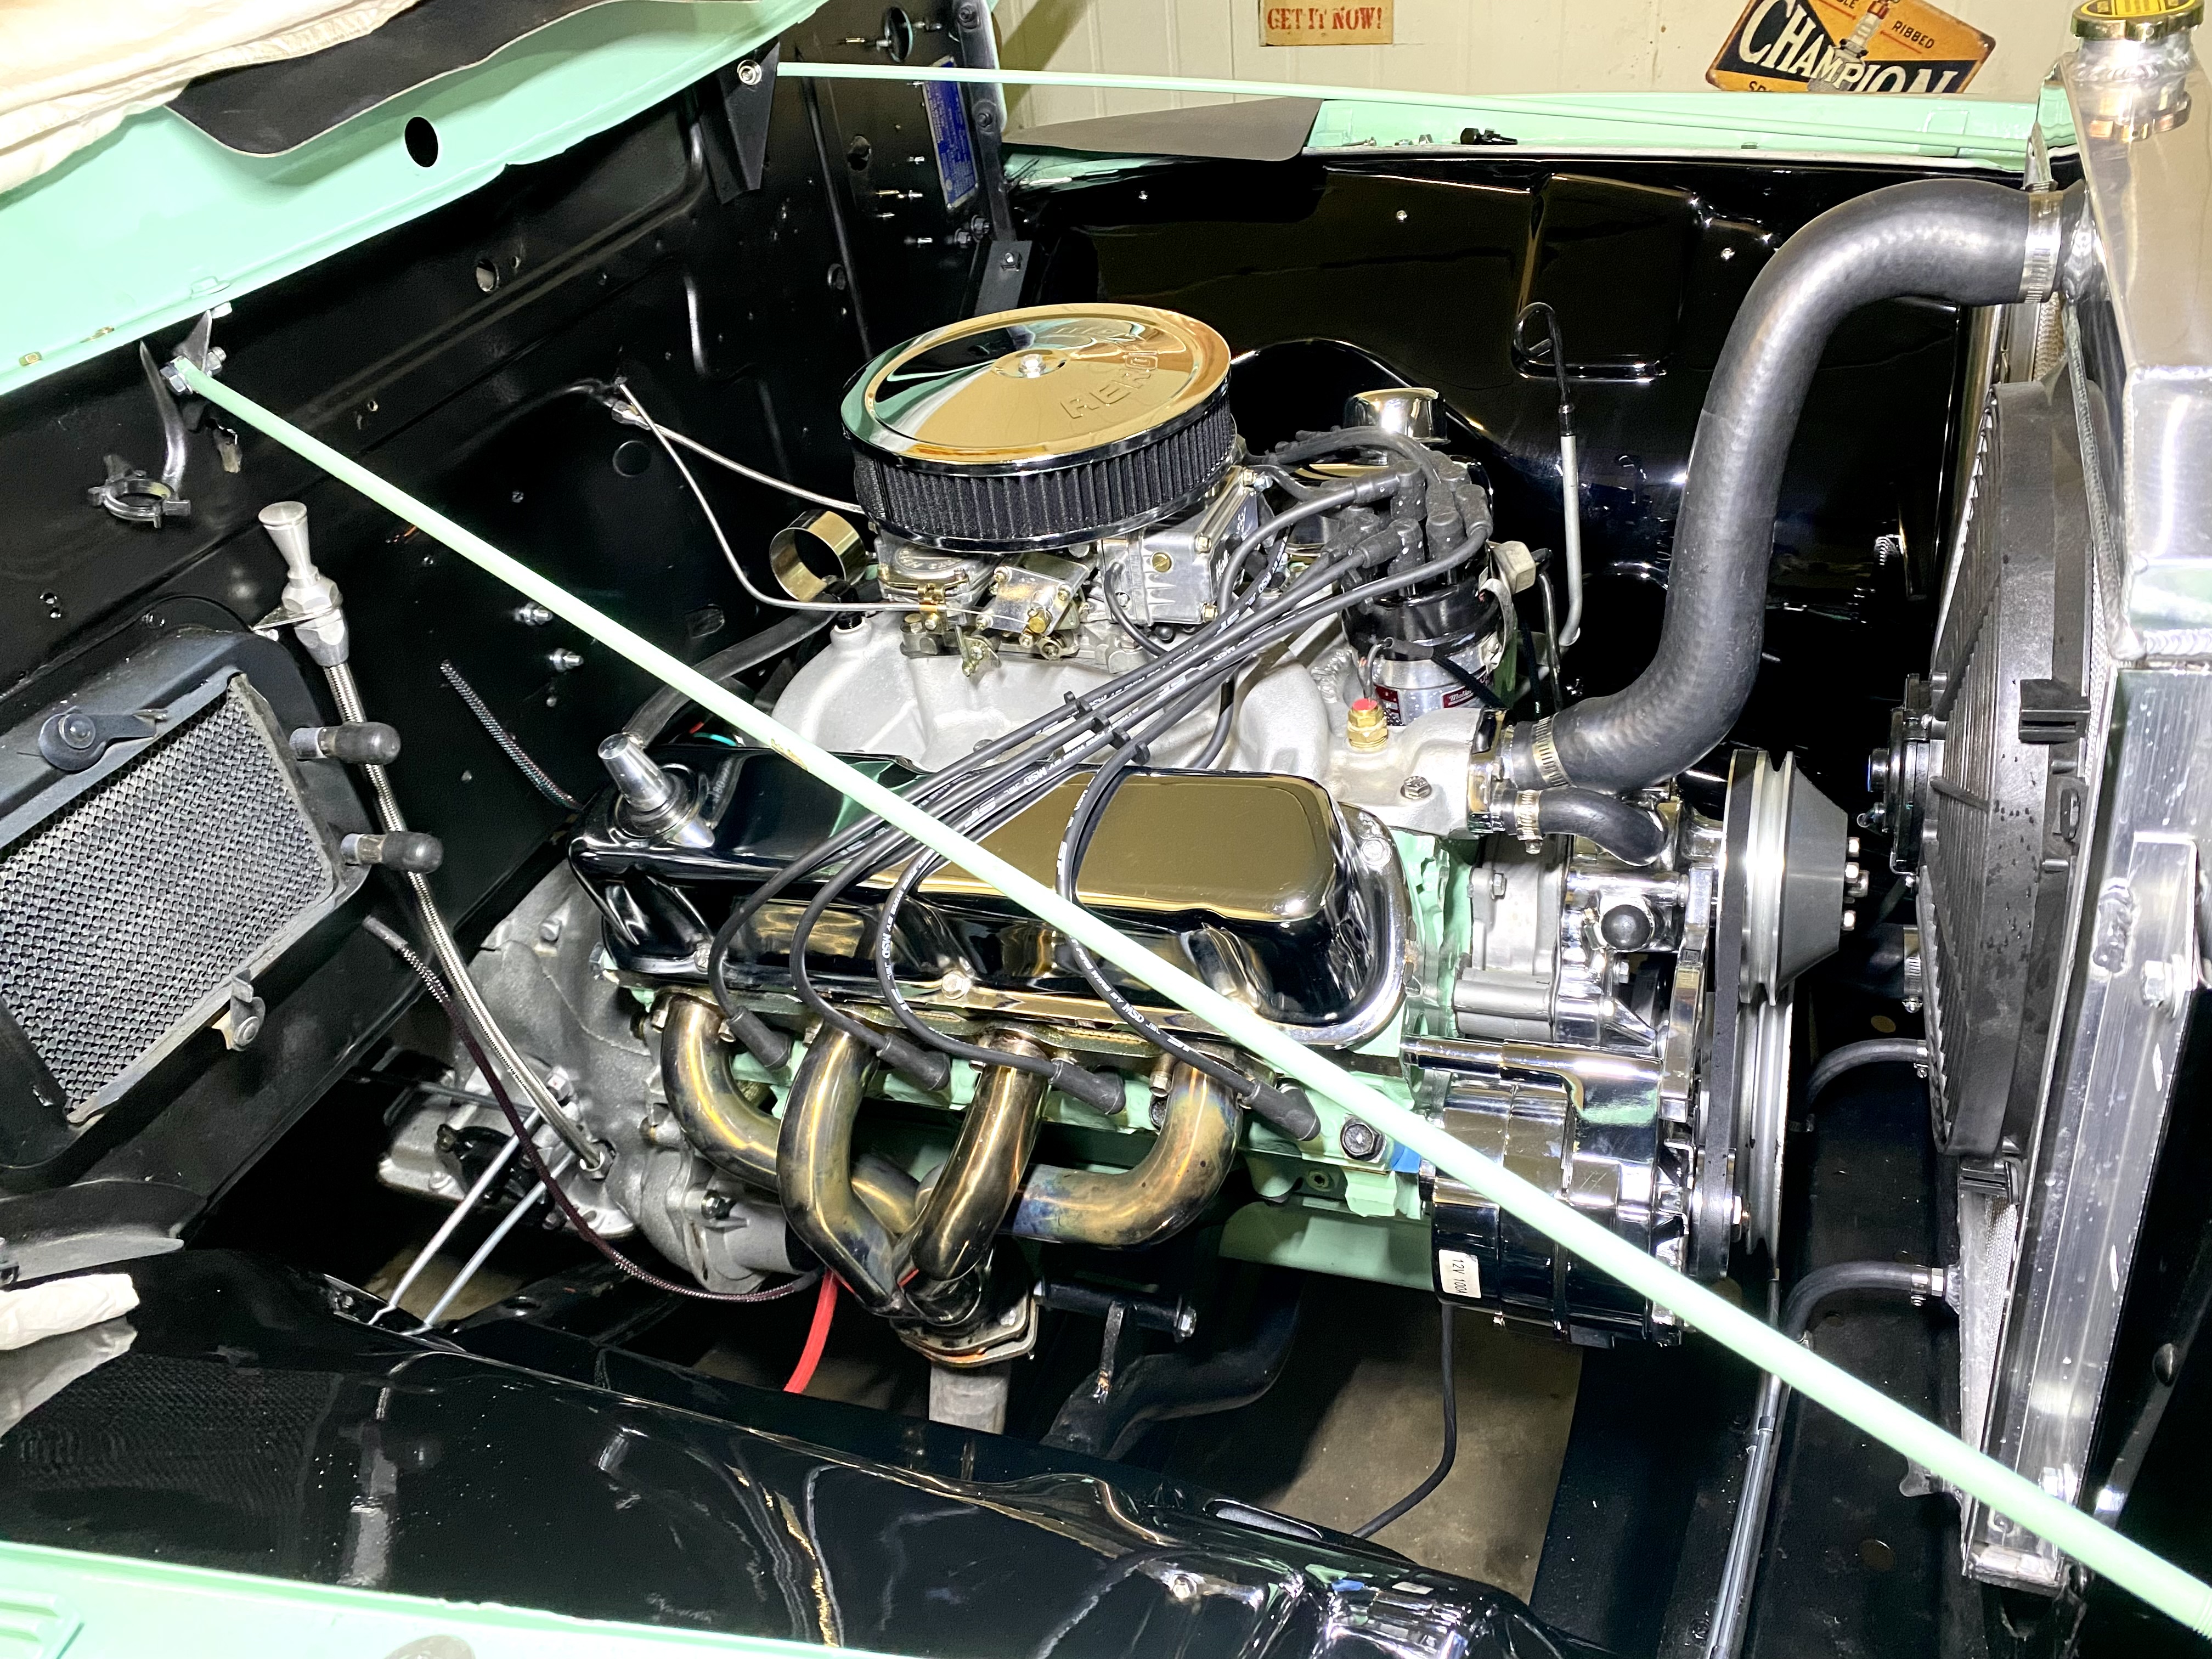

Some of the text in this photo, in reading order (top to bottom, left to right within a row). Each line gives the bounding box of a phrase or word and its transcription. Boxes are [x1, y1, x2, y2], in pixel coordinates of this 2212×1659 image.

[1267, 7, 1383, 30] GET IT NOW!
[1891, 20, 1935, 49] RIBBED
[1258, 572, 1272, 594] MSD
[1023, 766, 1047, 786] MSD
[890, 889, 904, 916] WIRE
[886, 916, 894, 932] BY
[882, 933, 891, 959] MSD
[1075, 947, 1093, 970] FIRE
[1091, 969, 1112, 992] WIRE
[1110, 991, 1125, 1004] BY
[1121, 1003, 1145, 1024] MSD
[1452, 1259, 1468, 1294] 12V 100A
